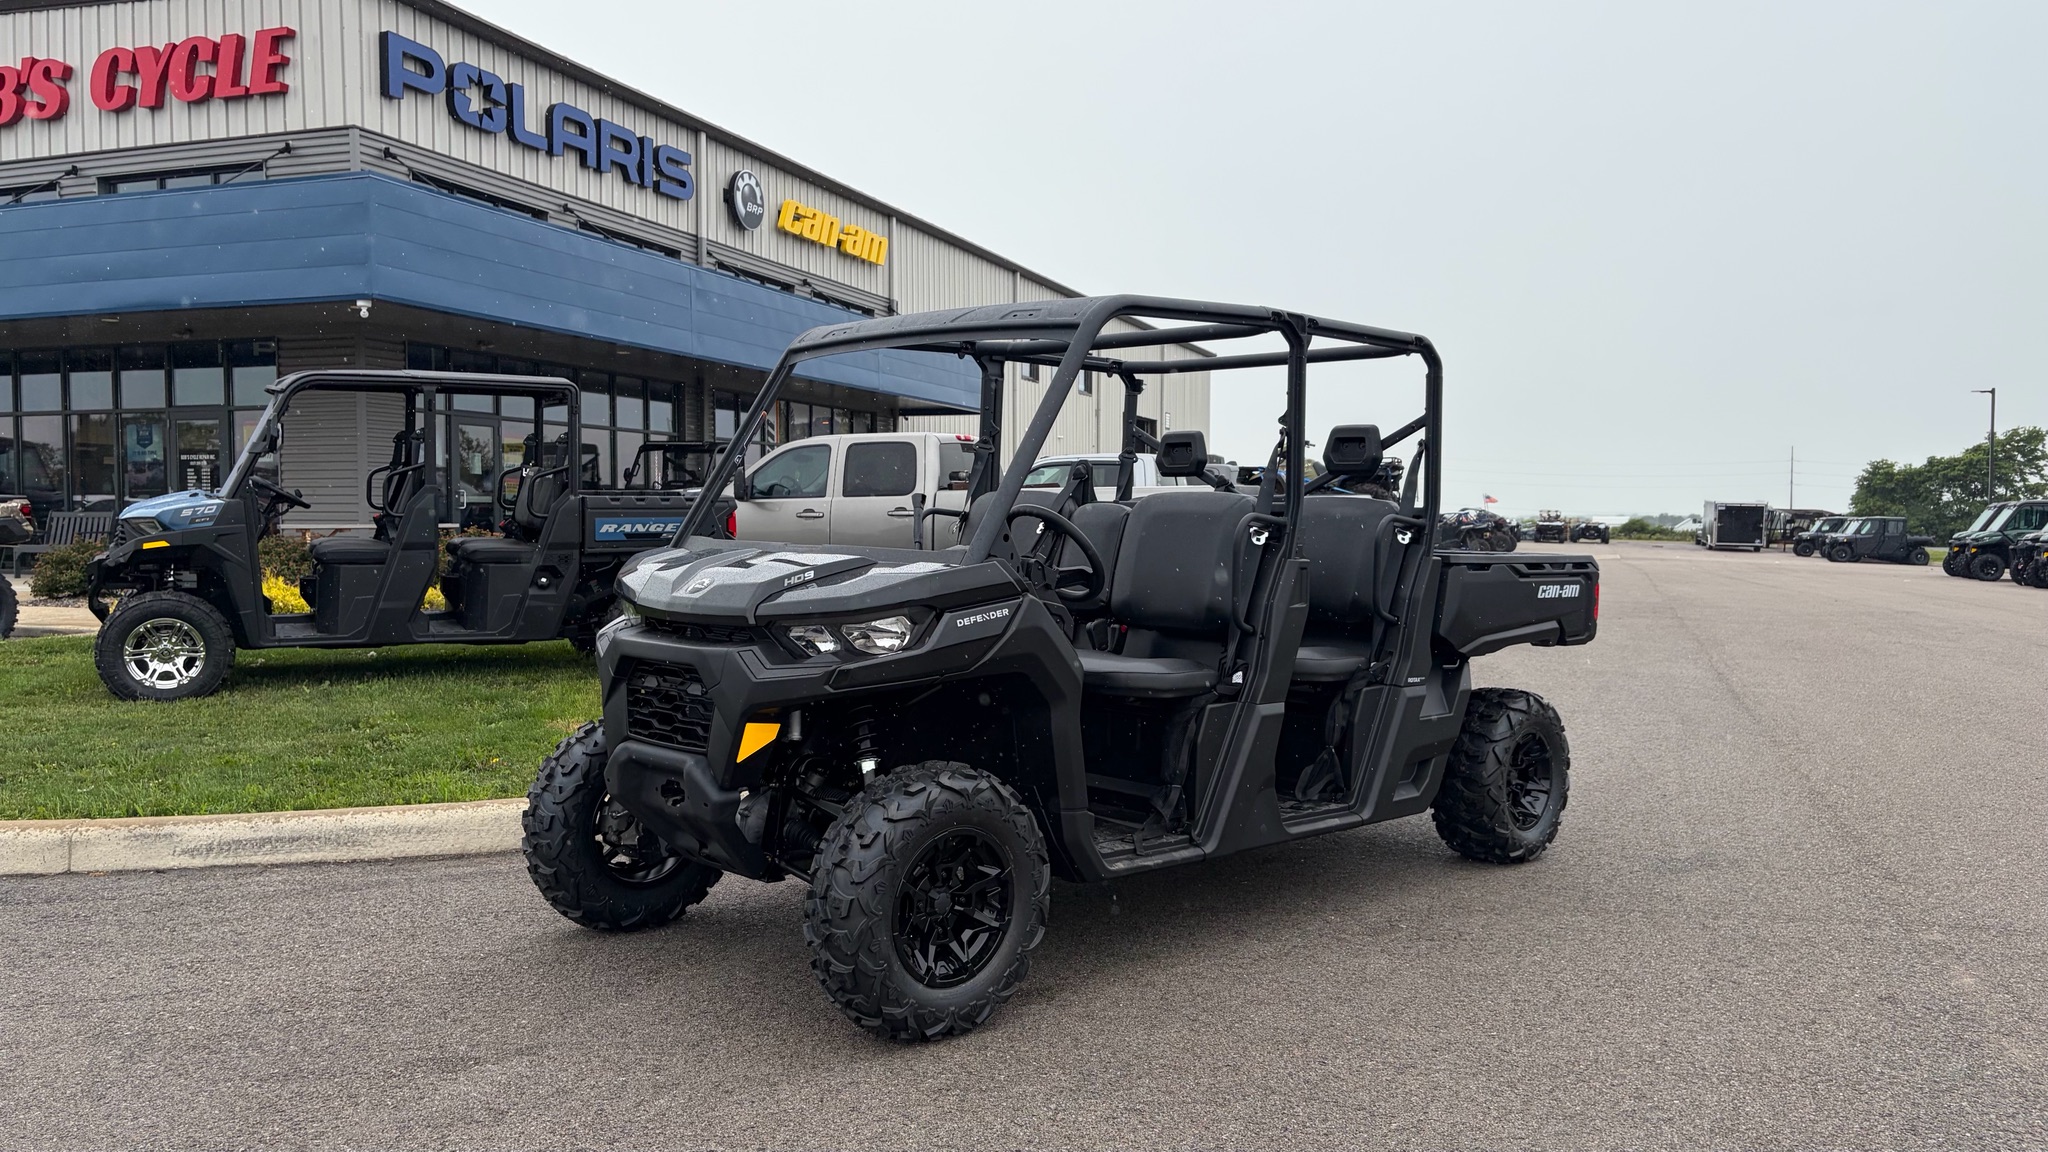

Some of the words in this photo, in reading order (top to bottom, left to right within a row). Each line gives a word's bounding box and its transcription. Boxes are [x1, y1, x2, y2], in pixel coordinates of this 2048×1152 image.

[90, 26, 296, 113] CYCLE
[379, 30, 695, 201] POLARIS
[746, 202, 763, 216] BRP
[180, 505, 217, 517] 570
[599, 523, 682, 533] RANGE
[784, 570, 815, 587] HD9
[956, 608, 1010, 628] DEFENDER
